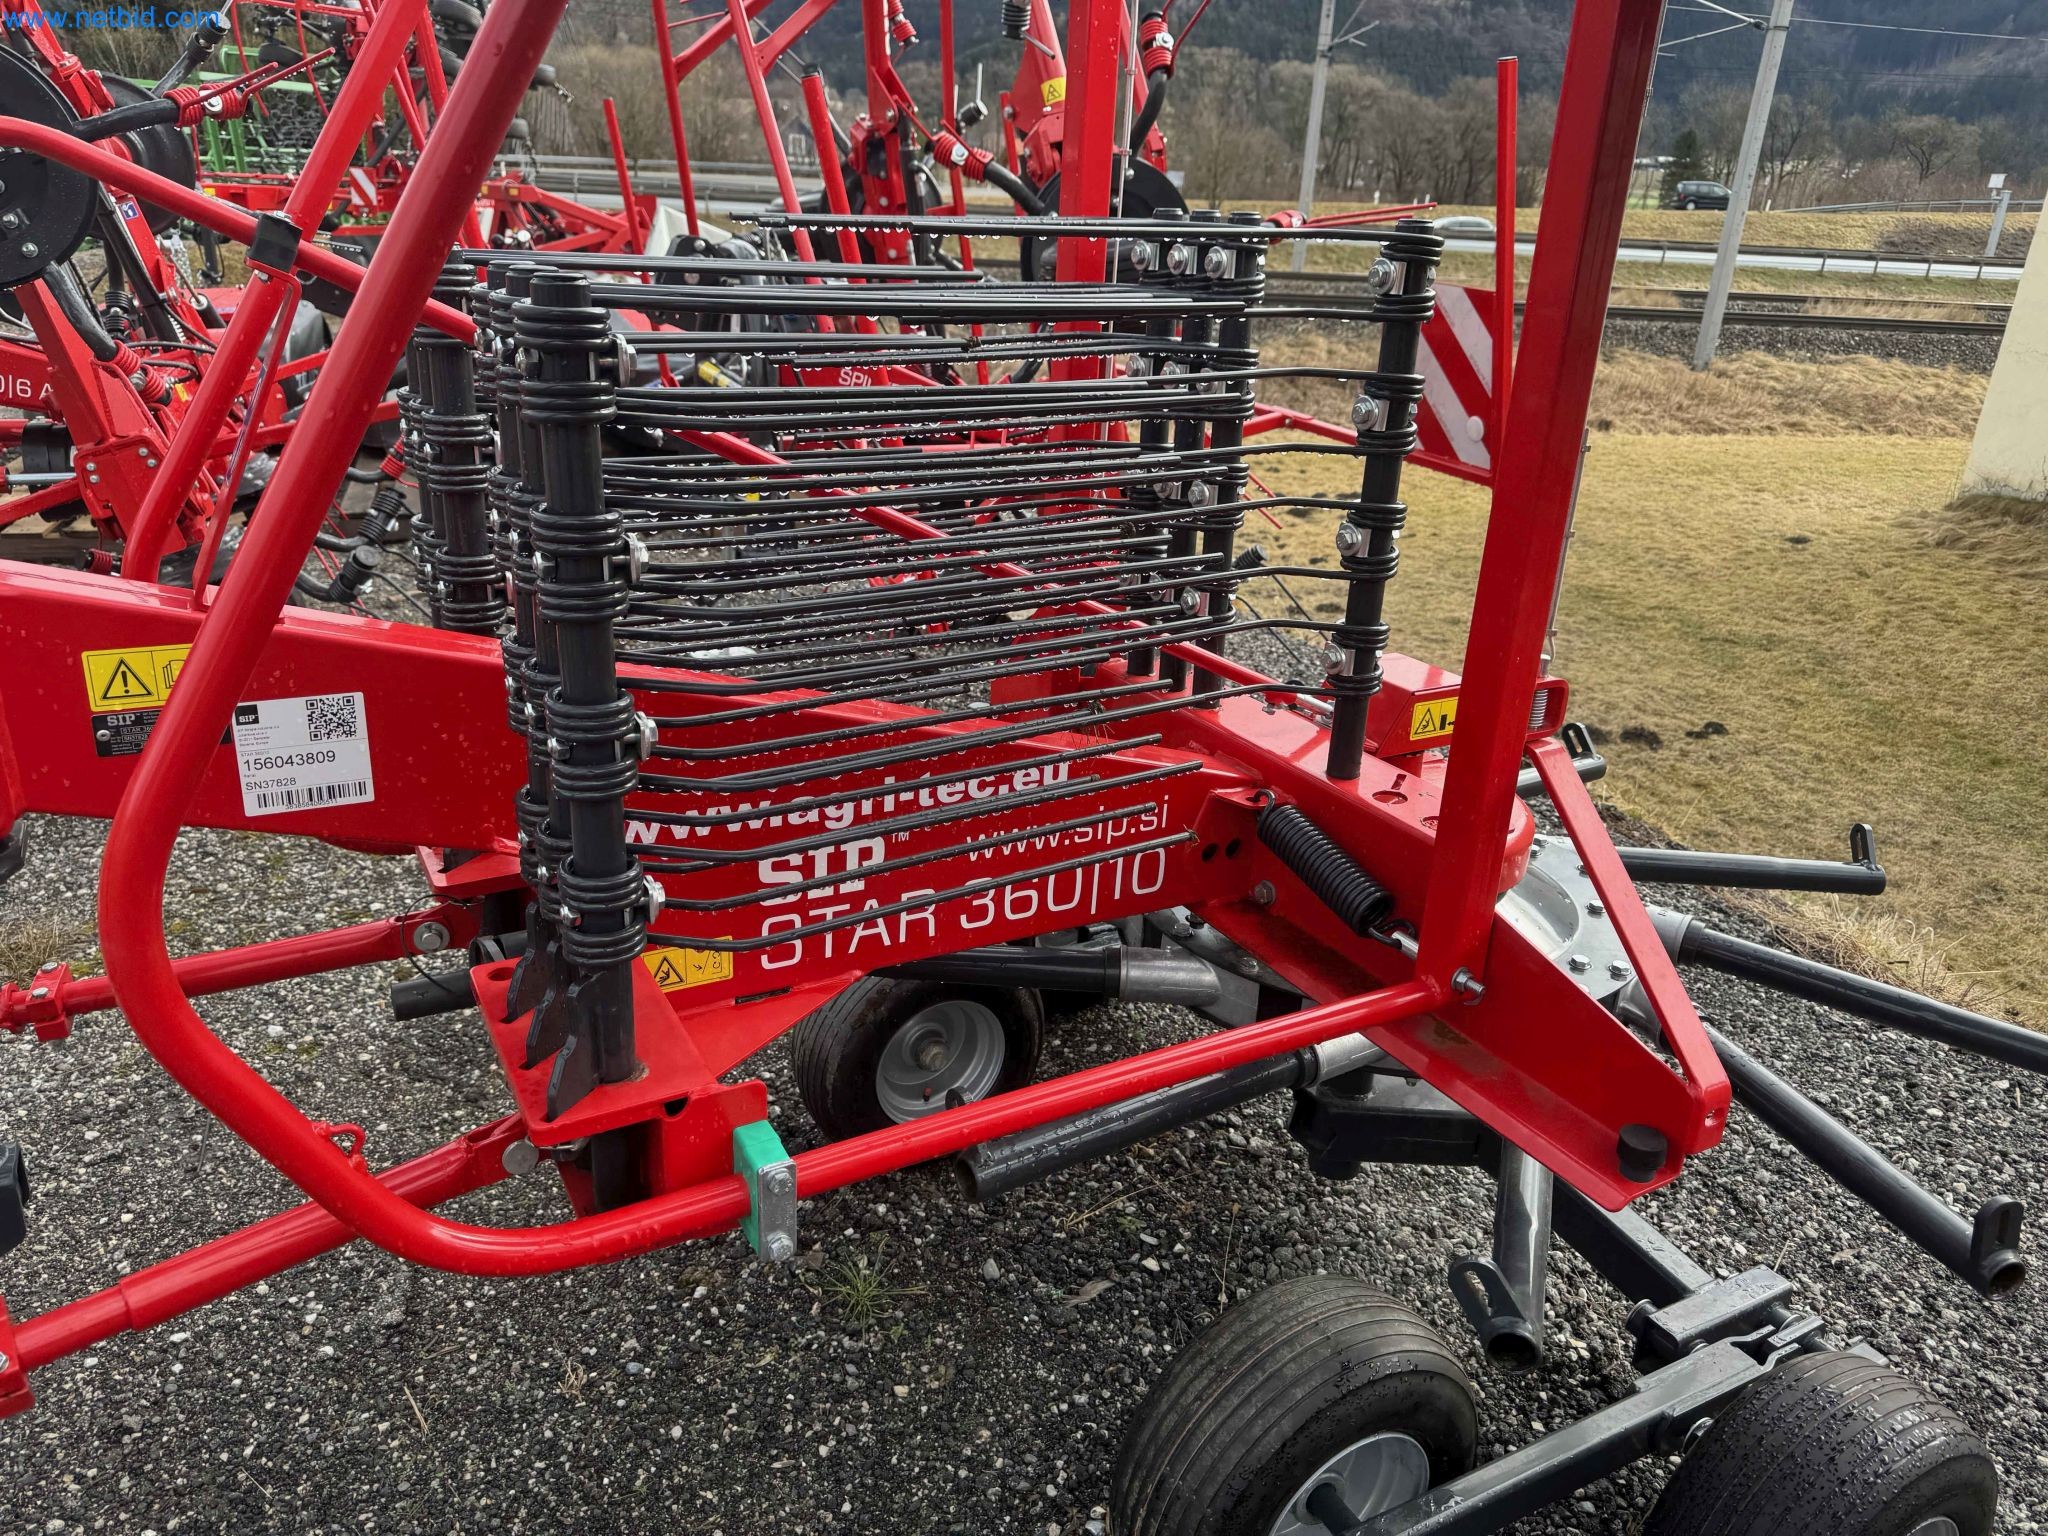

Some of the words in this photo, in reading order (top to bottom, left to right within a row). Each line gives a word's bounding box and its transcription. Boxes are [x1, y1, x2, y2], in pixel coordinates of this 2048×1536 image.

[107, 713, 136, 727] SIP
[239, 714, 256, 723] SIP
[243, 749, 336, 772] 156043809
[245, 777, 297, 791] SN37828
[966, 794, 1170, 863] www.sip.si
[757, 836, 887, 907] SIP
[759, 888, 937, 971] STAR
